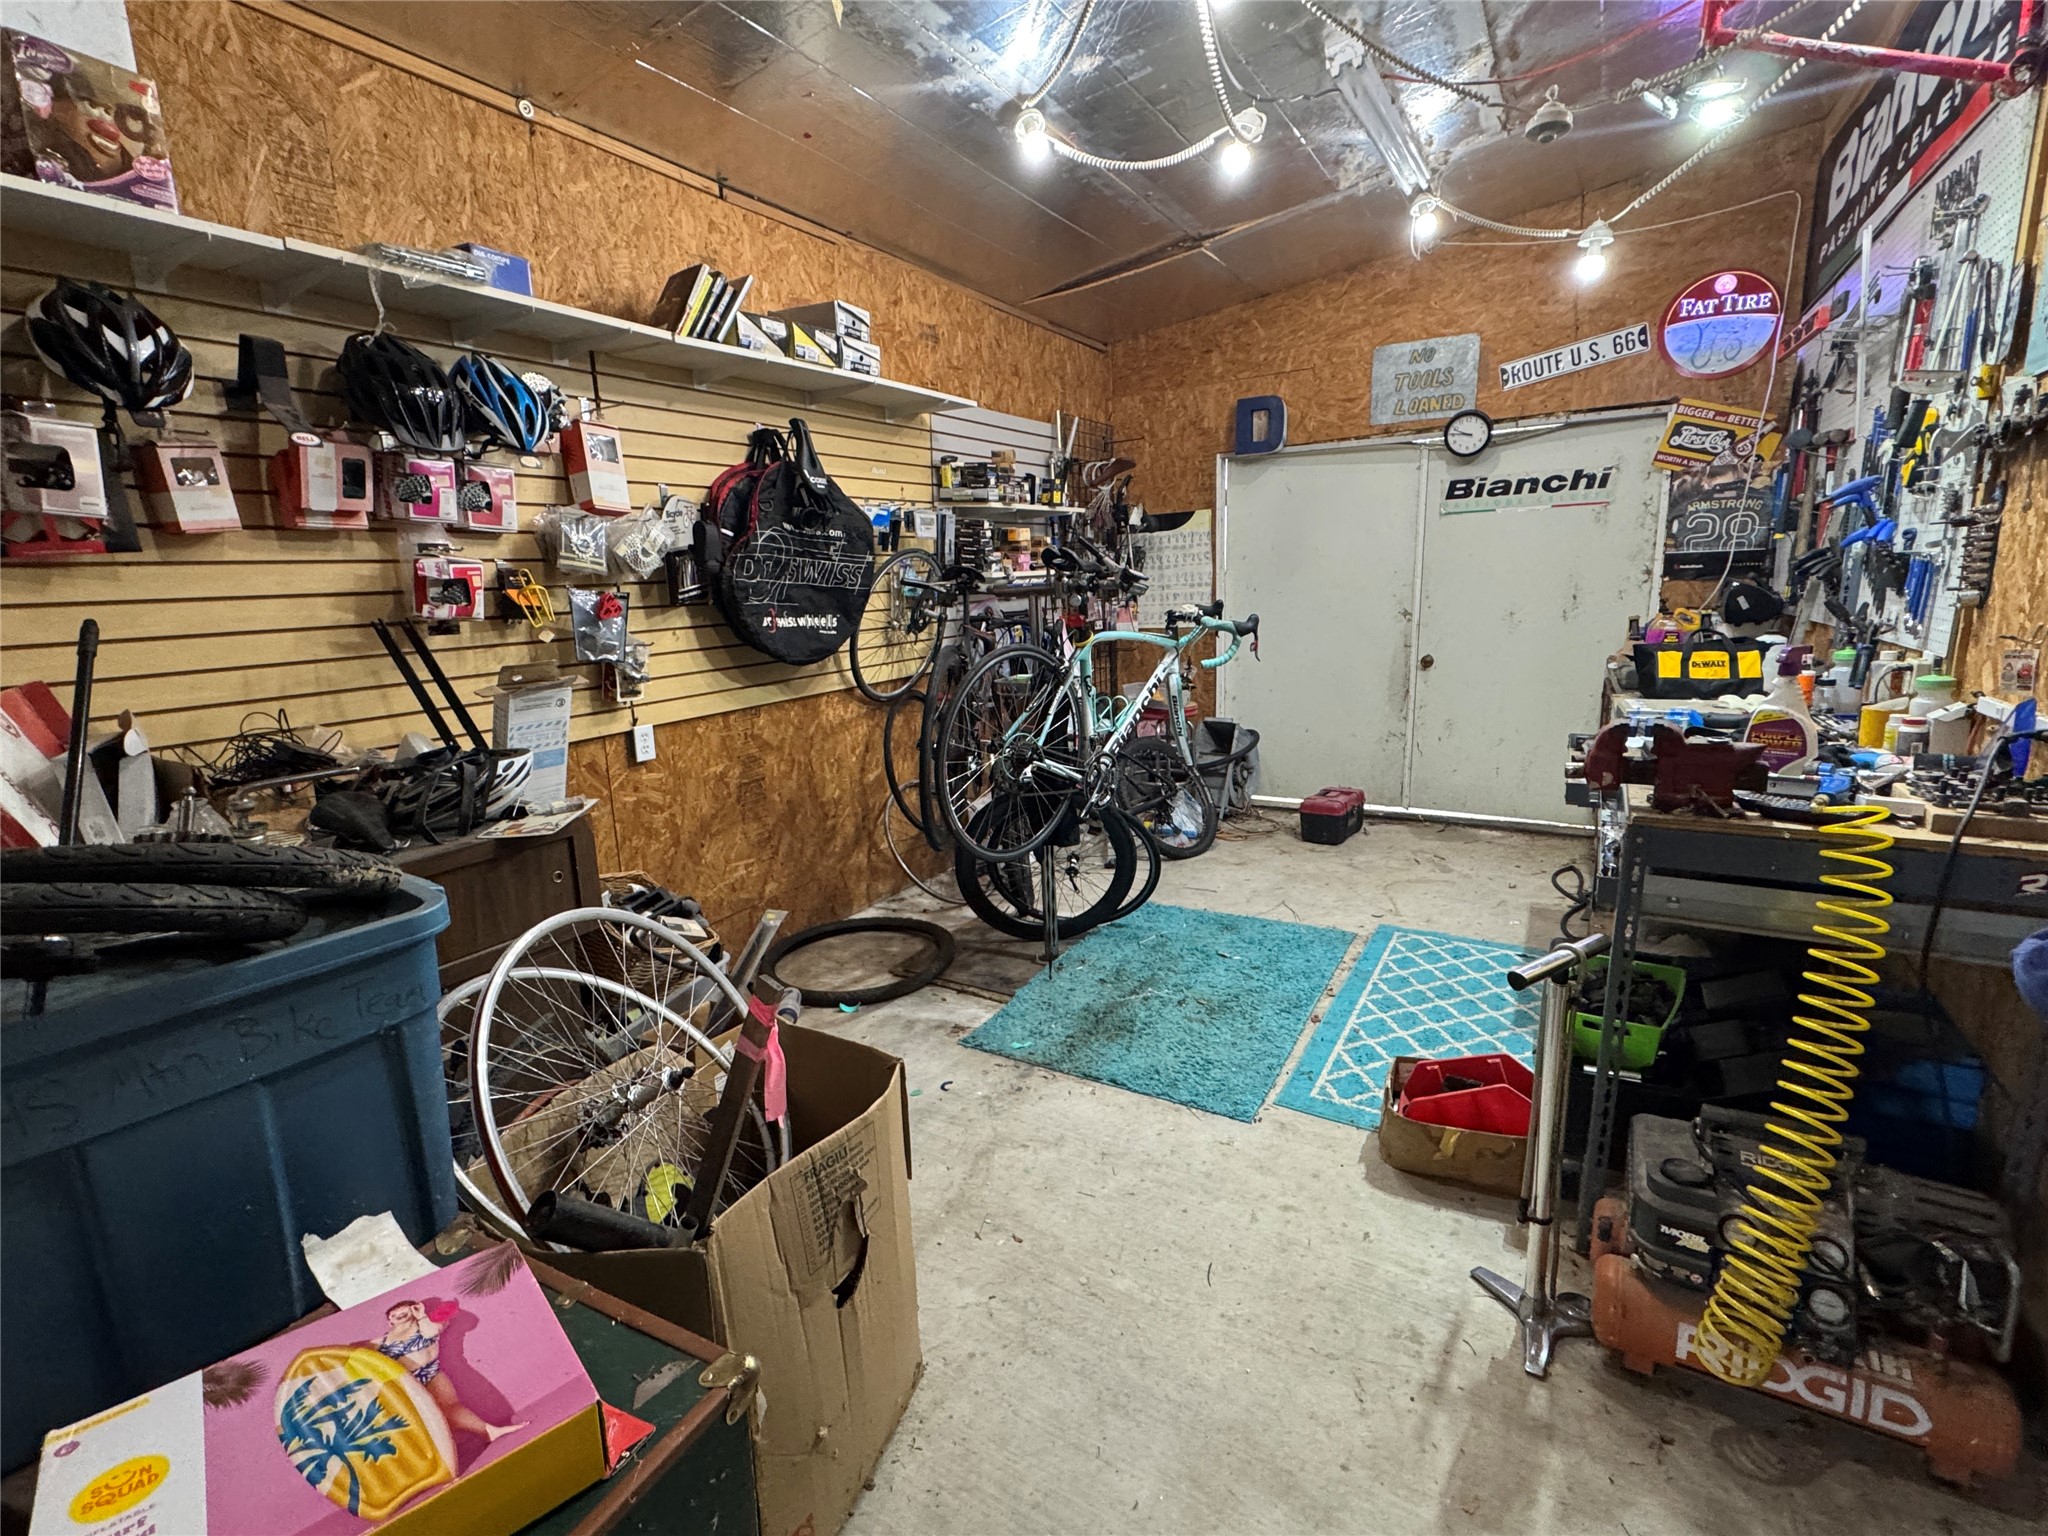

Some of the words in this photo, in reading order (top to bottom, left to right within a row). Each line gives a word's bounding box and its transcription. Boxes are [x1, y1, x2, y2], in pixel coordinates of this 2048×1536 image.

[1818, 165, 1890, 263] PASSIONE
[1679, 298, 1718, 317] FAT
[1720, 292, 1773, 313] TIRE
[1409, 347, 1437, 364] NO
[1511, 351, 1563, 384] ROUTE
[1571, 341, 1607, 367] U.S.
[1613, 331, 1636, 355] 66
[1394, 366, 1454, 392] TOOLS
[1393, 393, 1465, 416] LOANED
[1677, 405, 1715, 420] BIGGER
[1656, 454, 1681, 464] WORTH
[1445, 466, 1614, 501] Bianchi
[1687, 499, 1764, 512] ARMSTRONG
[1684, 511, 1760, 551] 28
[81, 1473, 159, 1515] SQUAD
